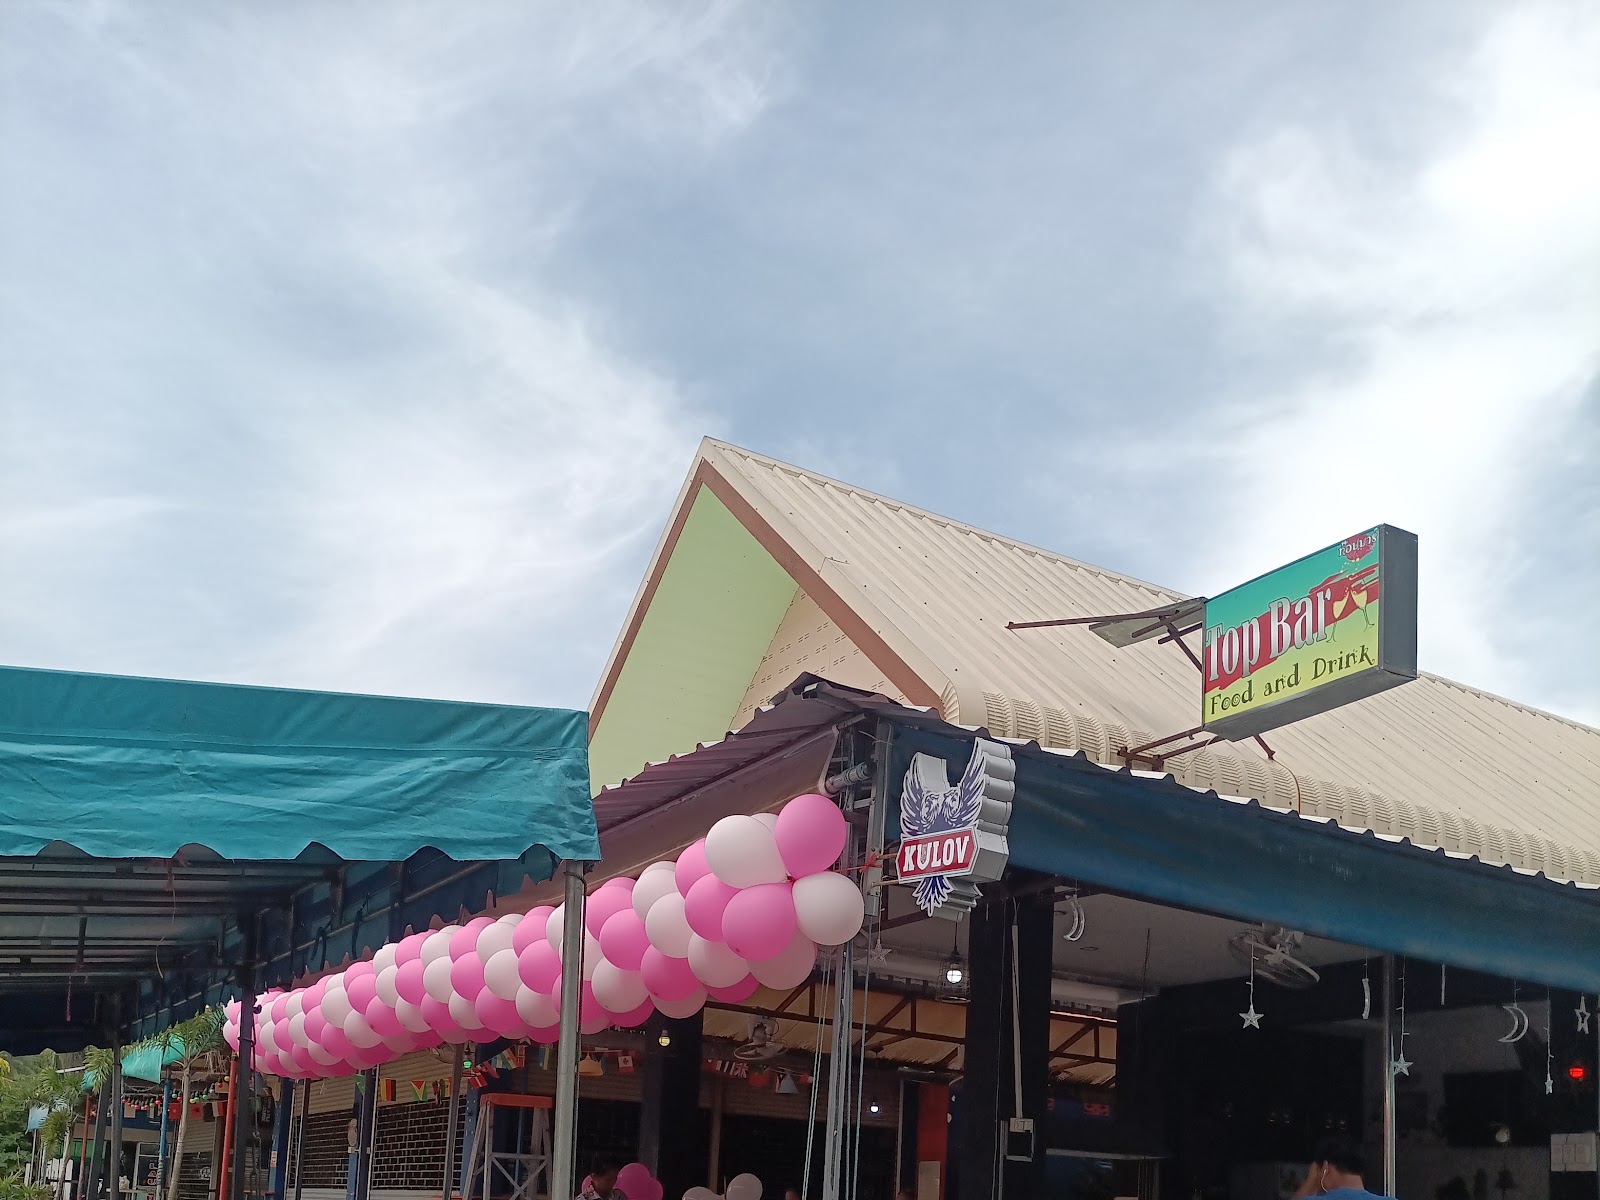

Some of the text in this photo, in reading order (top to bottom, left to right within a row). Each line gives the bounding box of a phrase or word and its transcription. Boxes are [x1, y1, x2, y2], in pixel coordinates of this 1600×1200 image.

[1205, 587, 1331, 682] Top Bar
[1211, 645, 1375, 714] Food and Drink
[902, 835, 970, 873] KULOV
